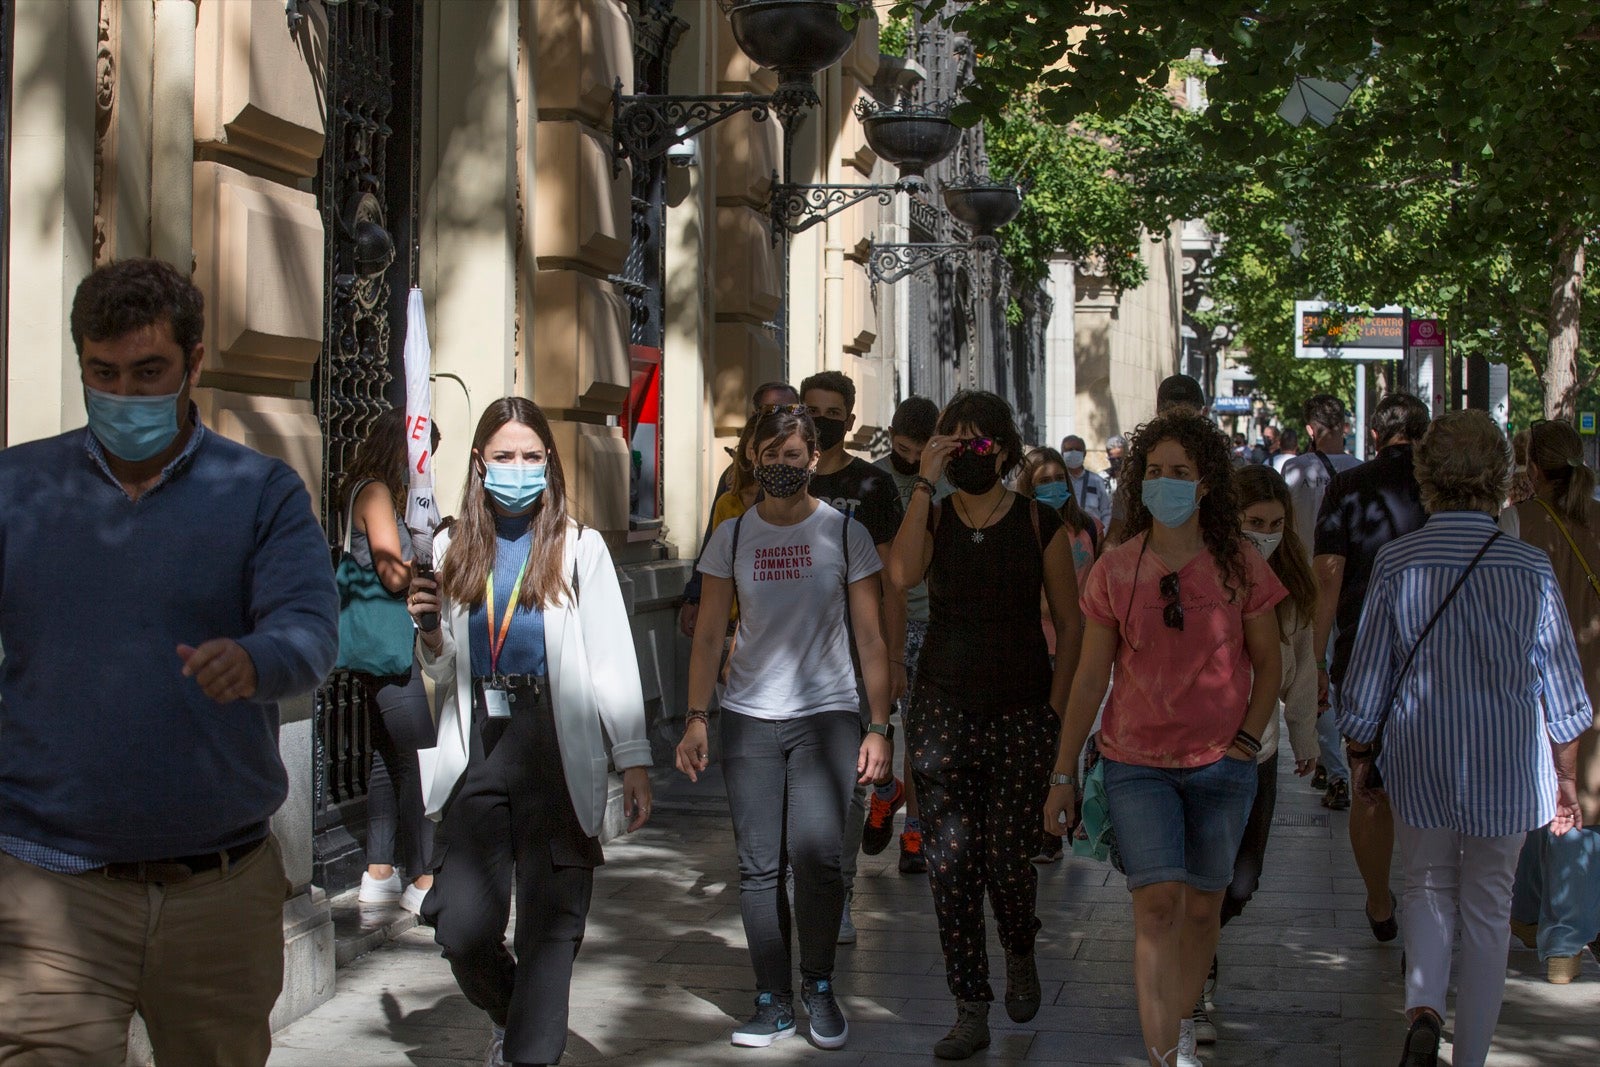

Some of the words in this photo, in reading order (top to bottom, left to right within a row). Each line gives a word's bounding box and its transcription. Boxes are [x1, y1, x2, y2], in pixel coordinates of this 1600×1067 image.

[1372, 317, 1403, 327] CENTRO
[1365, 328, 1377, 336] LA
[1378, 328, 1401, 337] VEGA
[755, 544, 811, 559] SARCASTIC
[753, 556, 813, 570] COMMENTS
[753, 569, 813, 581] LOADING...
